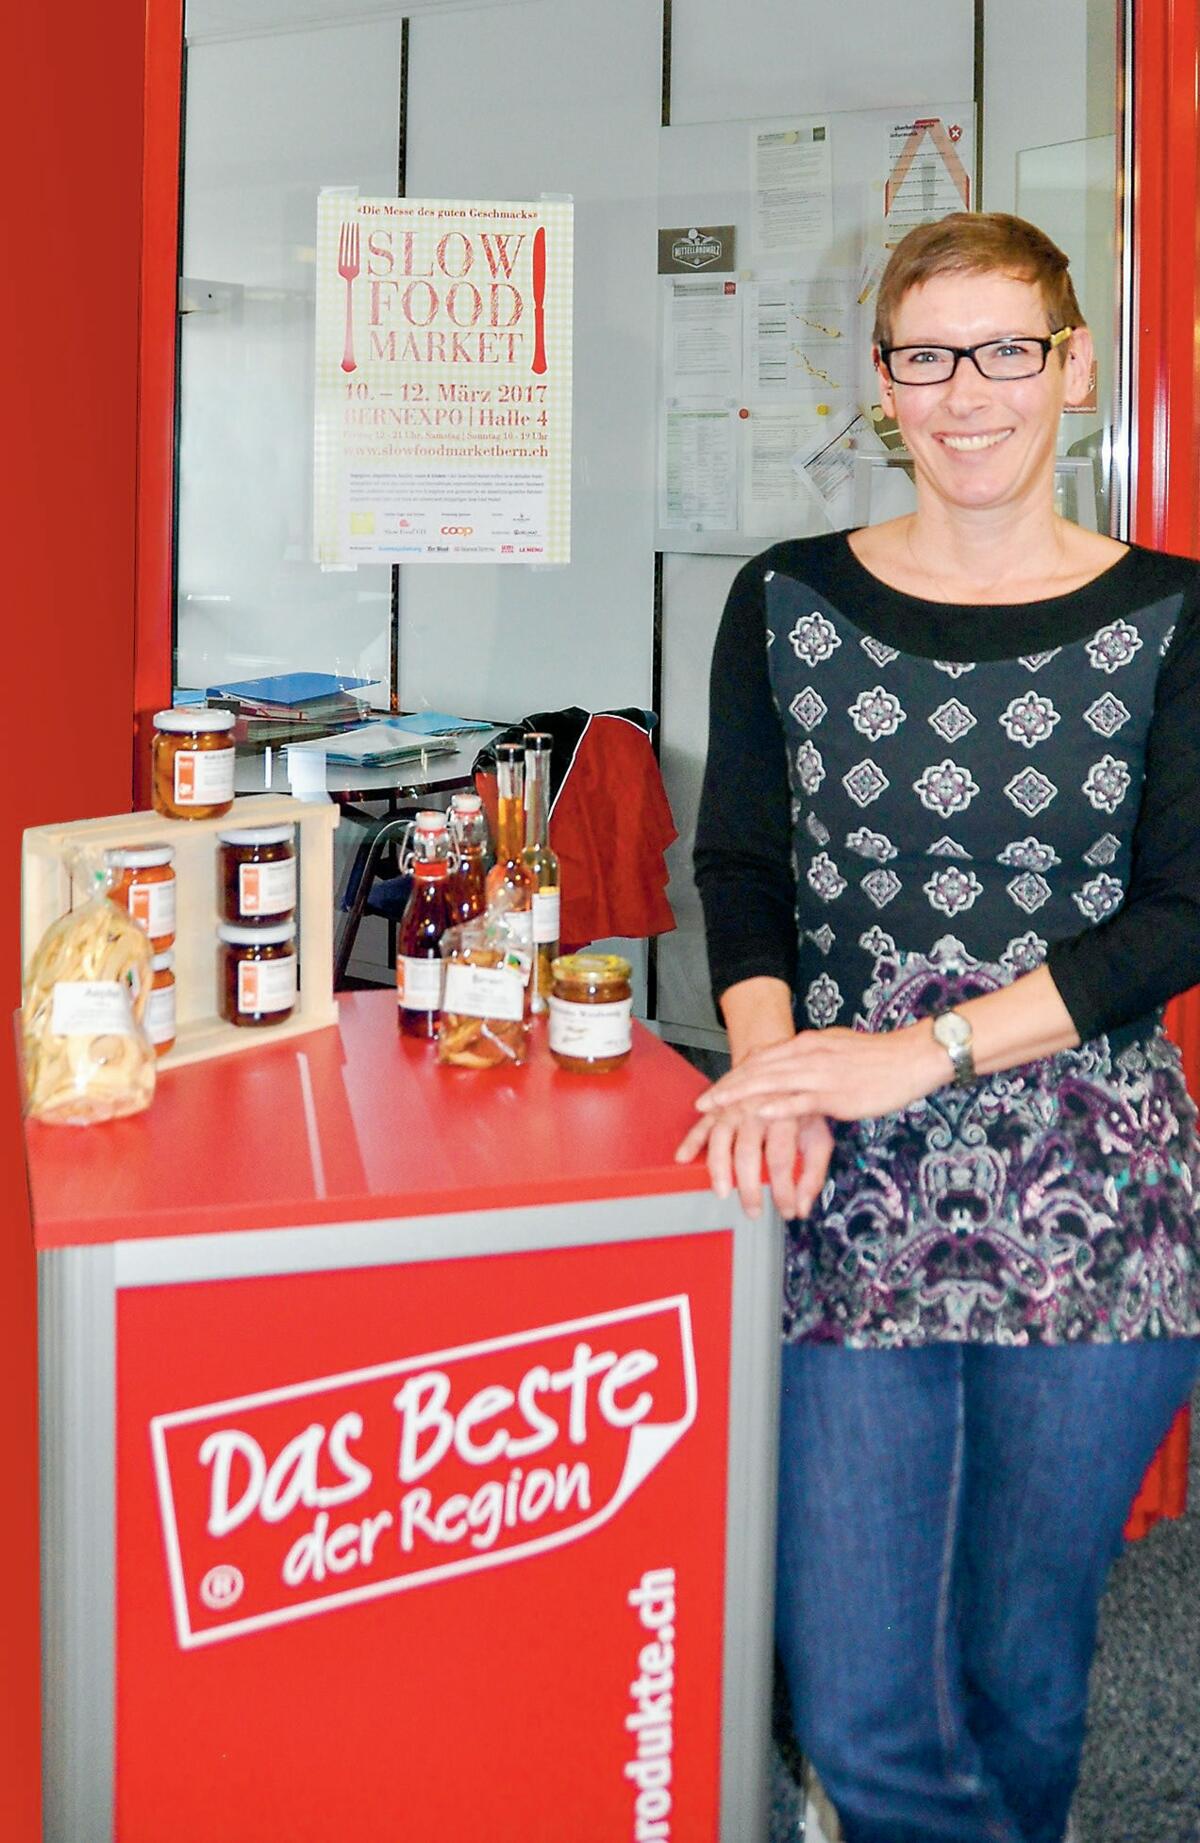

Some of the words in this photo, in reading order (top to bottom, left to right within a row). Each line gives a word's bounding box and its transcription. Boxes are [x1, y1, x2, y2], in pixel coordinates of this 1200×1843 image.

[383, 206, 414, 216] Messe
[417, 206, 435, 216] des
[437, 208, 466, 219] guten
[367, 230, 526, 279] SLOW
[367, 280, 524, 327] FOOD
[369, 331, 524, 363] MARKET
[345, 382, 375, 401] 10.
[400, 383, 430, 402] 12.
[437, 383, 492, 403] März
[498, 384, 548, 403] 2017
[344, 407, 463, 426] BERNEXPO
[480, 408, 530, 426] Halle
[536, 409, 548, 426] 4
[521, 432, 530, 440] 19
[532, 432, 548, 440] Uhr
[440, 526, 474, 537] coop
[199, 1412, 374, 1537] Das
[393, 1342, 659, 1483] Beste
[282, 1510, 393, 1587] der
[400, 1460, 592, 1553] Region
[625, 1566, 677, 1843] rodukte.ch
